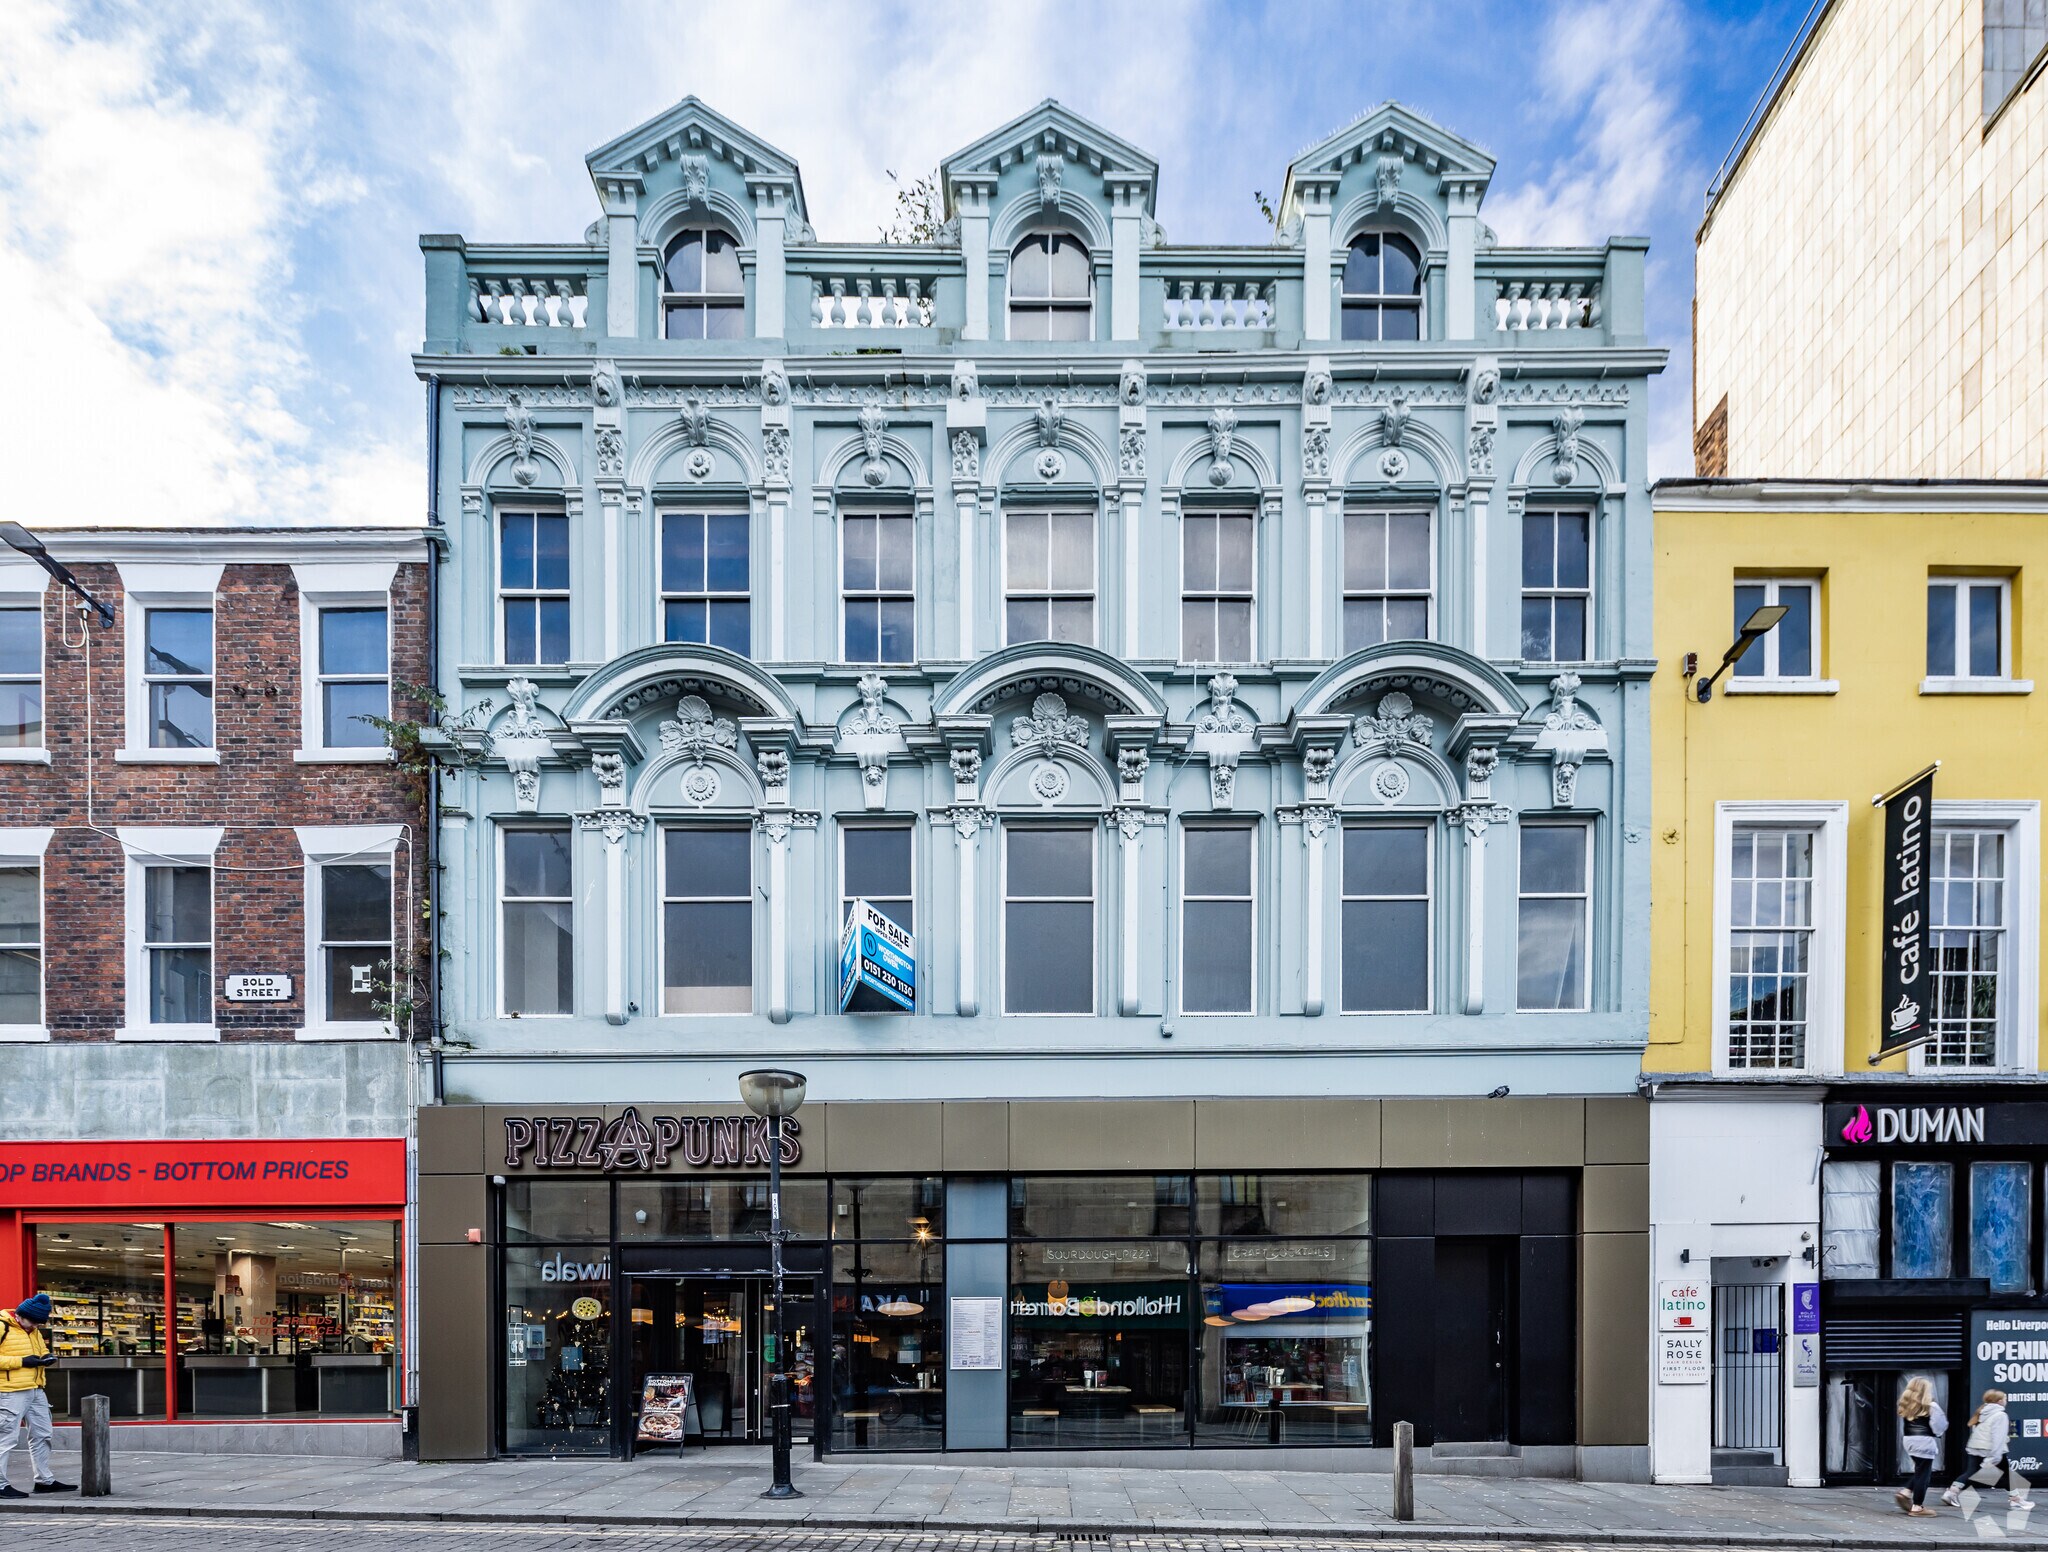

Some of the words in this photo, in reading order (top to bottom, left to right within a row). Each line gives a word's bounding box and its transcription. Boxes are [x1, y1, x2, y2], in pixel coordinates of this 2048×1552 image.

[1893, 795, 1922, 905] latino
[867, 908, 886, 931] FOR
[888, 923, 910, 948] SALE
[1892, 909, 1920, 985] café
[877, 942, 913, 972] WORTHINGTON
[242, 978, 274, 986] BOLD
[863, 959, 881, 978] 0151
[882, 970, 897, 987] 230
[898, 979, 913, 998] 1130
[236, 988, 281, 997] STREET
[1877, 1107, 1984, 1143] DUMAN
[653, 1115, 802, 1166] PUNKS
[32, 1162, 131, 1182] BRANDS
[154, 1161, 256, 1181] BOTTOM
[262, 1160, 350, 1180] PRICES
[1047, 1248, 1116, 1260] SOURDOUGH
[1122, 1248, 1152, 1259] PIZZA
[1232, 1248, 1267, 1259] CRAFT
[1671, 1286, 1699, 1298] café
[1662, 1298, 1706, 1310] latino
[252, 1317, 279, 1326] TOP
[282, 1316, 333, 1326] BRANDS
[1986, 1319, 2011, 1331] Hello
[238, 1327, 290, 1336] BOTTOM
[294, 1326, 343, 1336] PRICES
[1666, 1339, 1703, 1348] SALLY
[1666, 1350, 1702, 1359] ROSE
[1993, 1363, 2048, 1383] SOON
[2008, 1393, 2036, 1402] BRITISH
